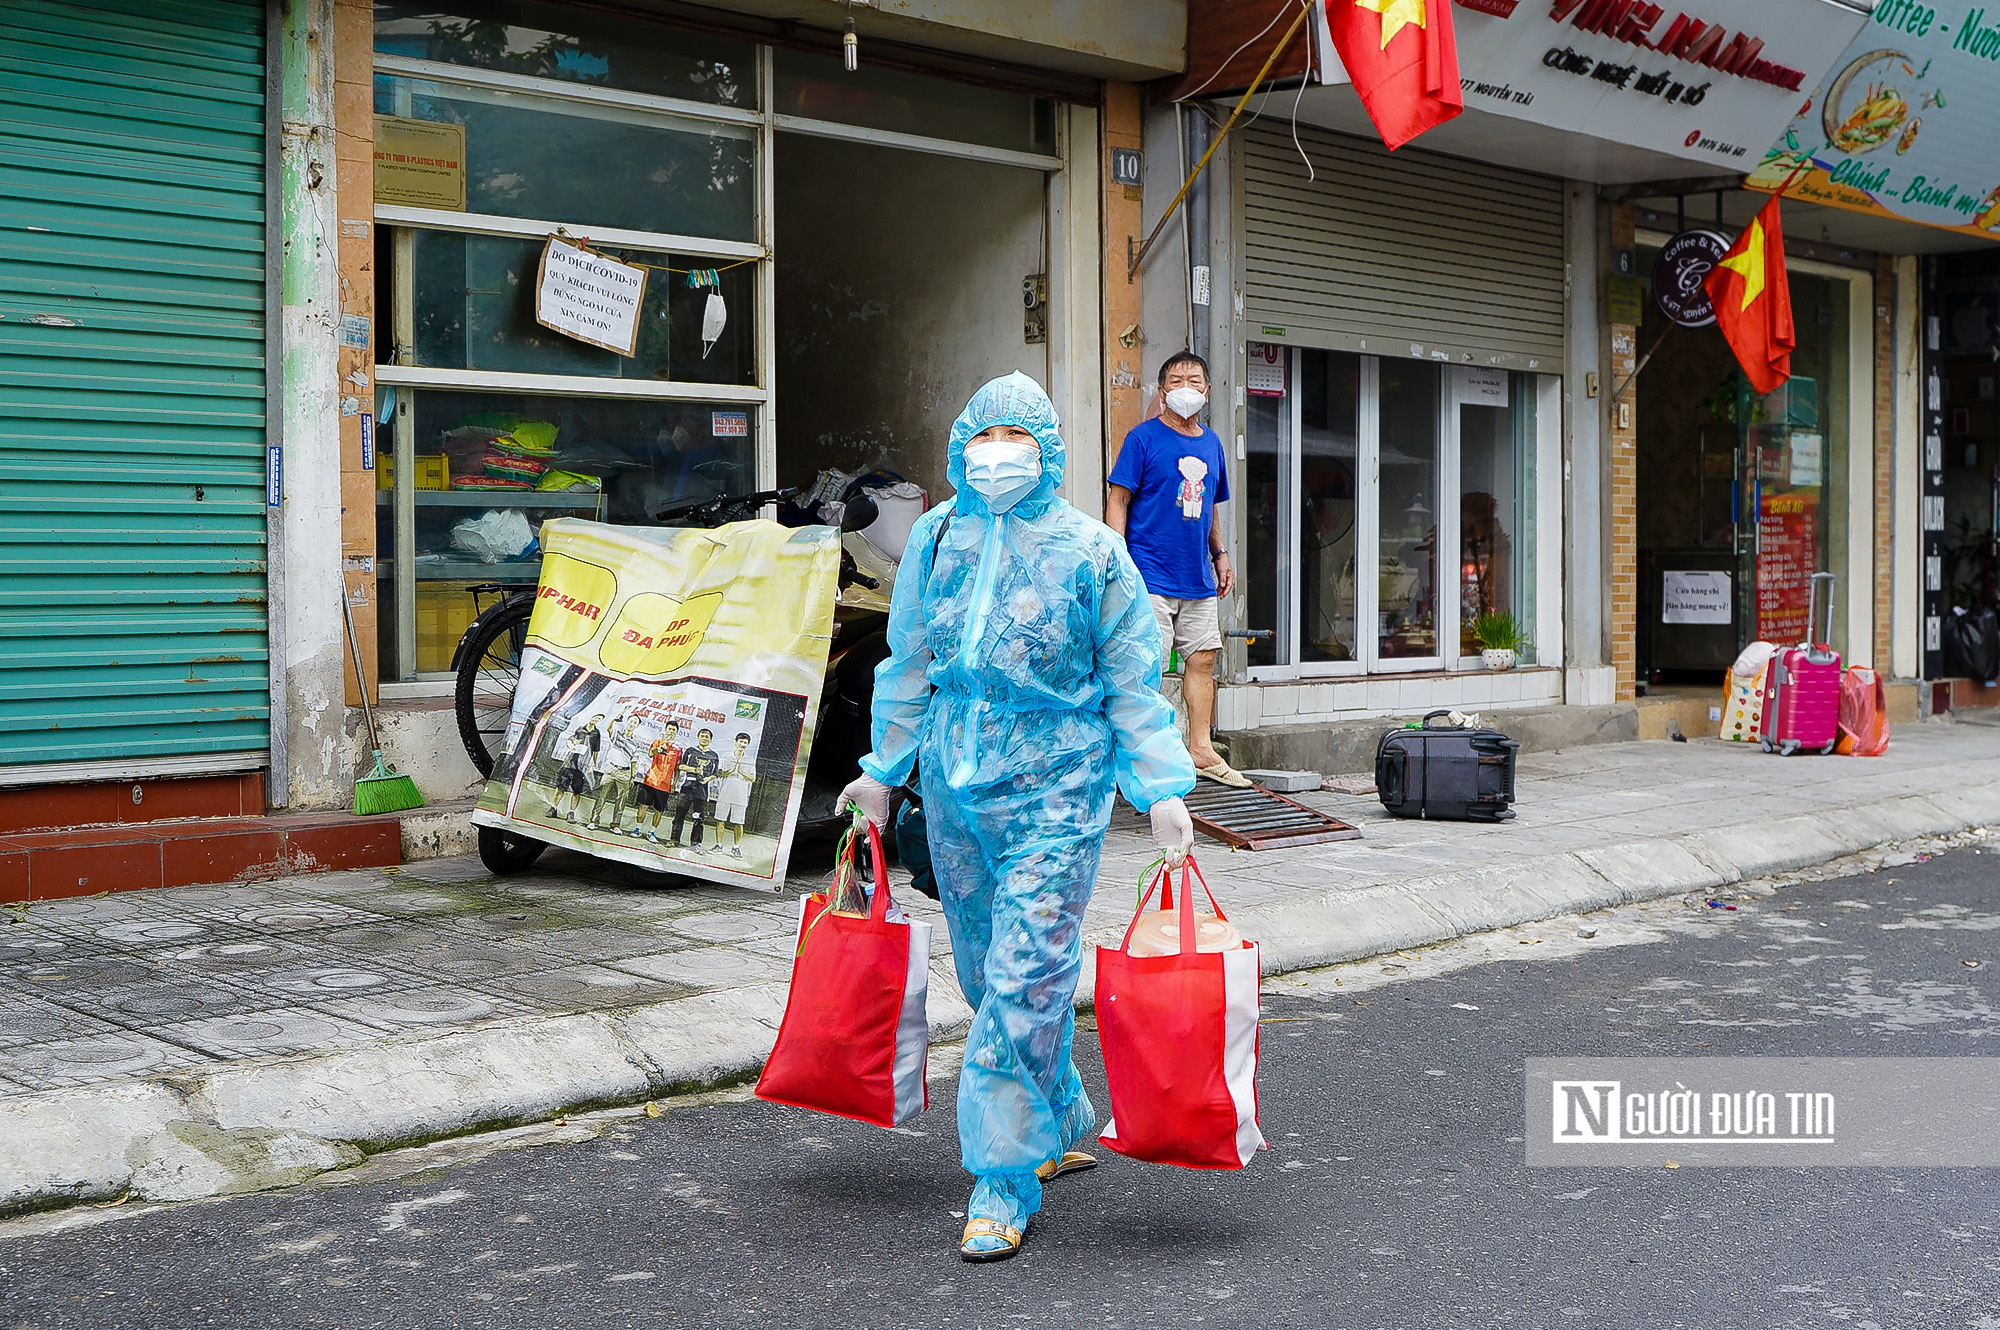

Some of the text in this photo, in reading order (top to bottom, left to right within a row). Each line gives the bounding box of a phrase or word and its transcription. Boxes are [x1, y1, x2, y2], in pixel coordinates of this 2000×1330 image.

[1119, 154, 1138, 179] 10
[1665, 238, 1697, 262] Coffee
[551, 250, 638, 287] DO DỊCH COVID-19
[1621, 253, 1628, 272] 6
[568, 276, 594, 293] KHÁCH
[596, 287, 611, 298] VUI
[611, 292, 635, 306] LÒNG
[560, 307, 575, 319] XIN
[665, 619, 690, 633] DP
[622, 629, 653, 650] ĐA
